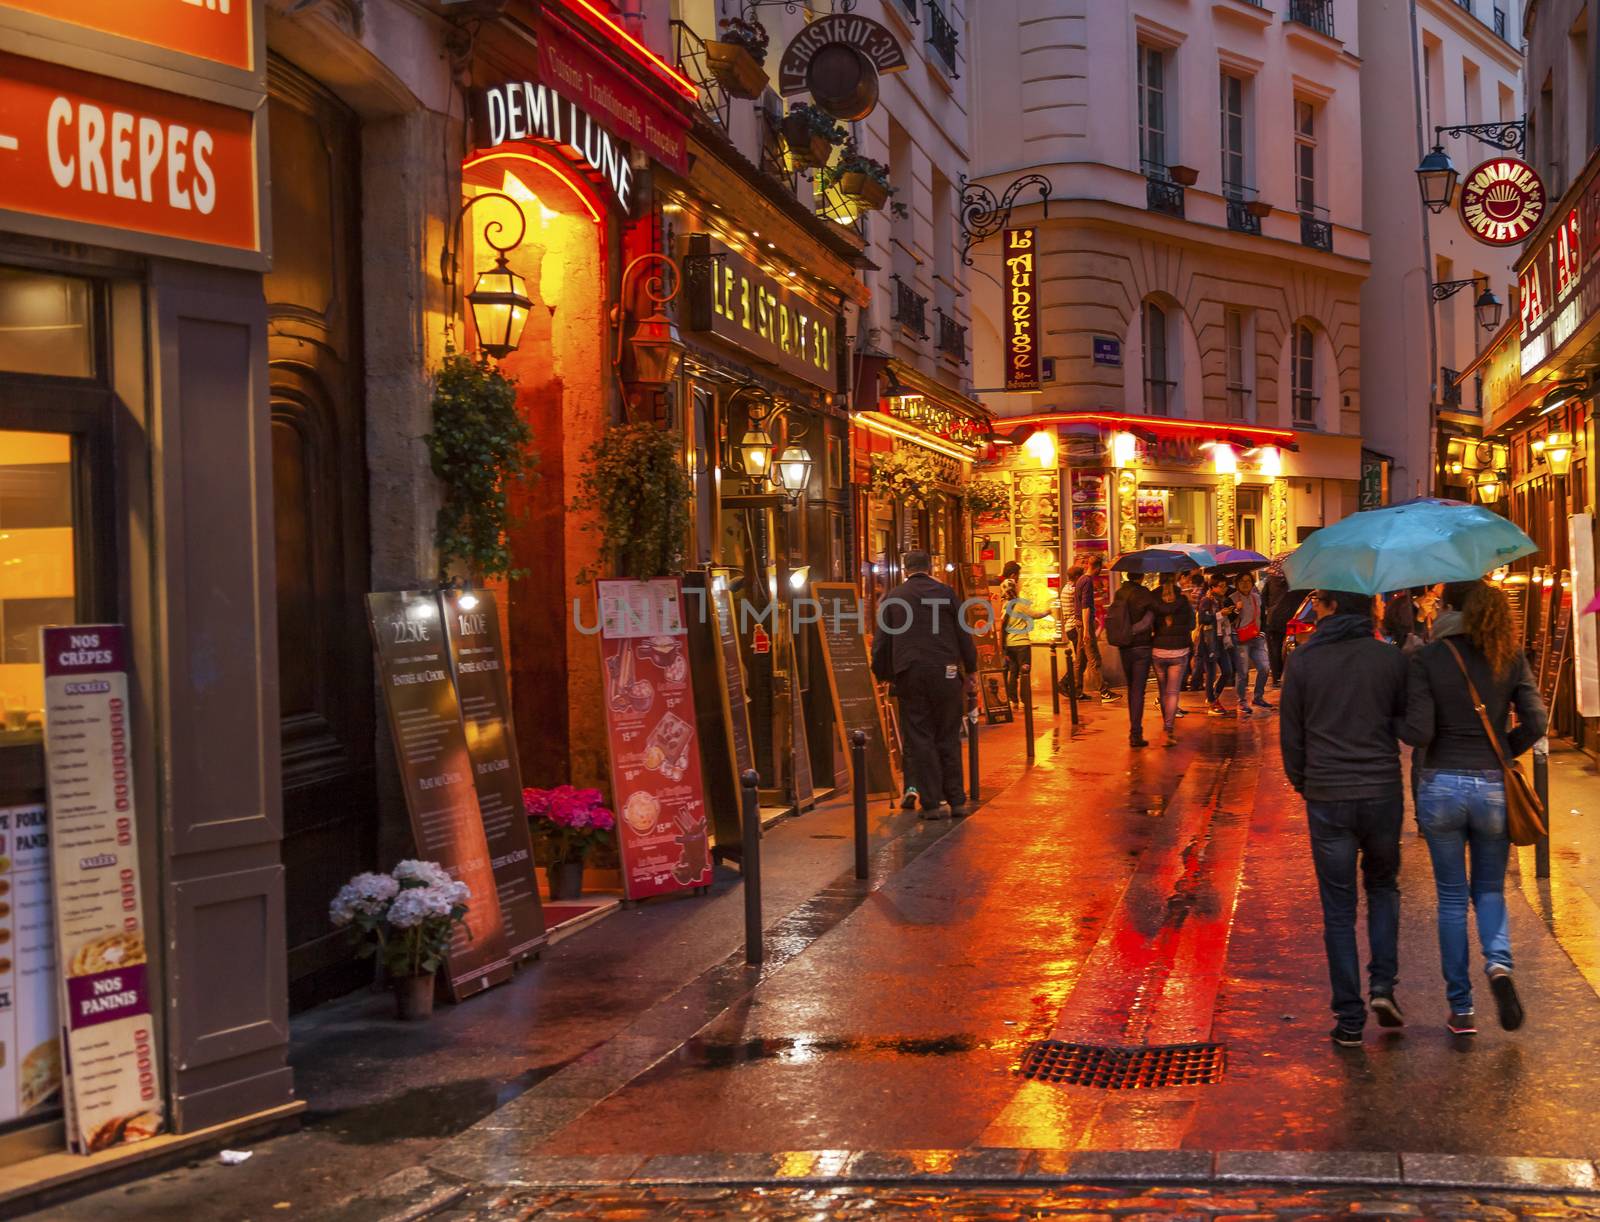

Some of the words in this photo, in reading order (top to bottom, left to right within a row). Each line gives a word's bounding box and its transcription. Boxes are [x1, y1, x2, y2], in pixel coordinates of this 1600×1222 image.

[47, 96, 216, 215] CREPES
[486, 81, 562, 146] DEMI
[570, 101, 634, 217] LUNE
[1466, 162, 1541, 196] FONDUES
[1464, 201, 1543, 240] RACLETTES
[712, 258, 735, 322] LE
[59, 649, 113, 667] CRÊPES
[70, 634, 100, 649] NOS
[93, 976, 122, 995] NOS
[81, 990, 137, 1016] PANINIS
